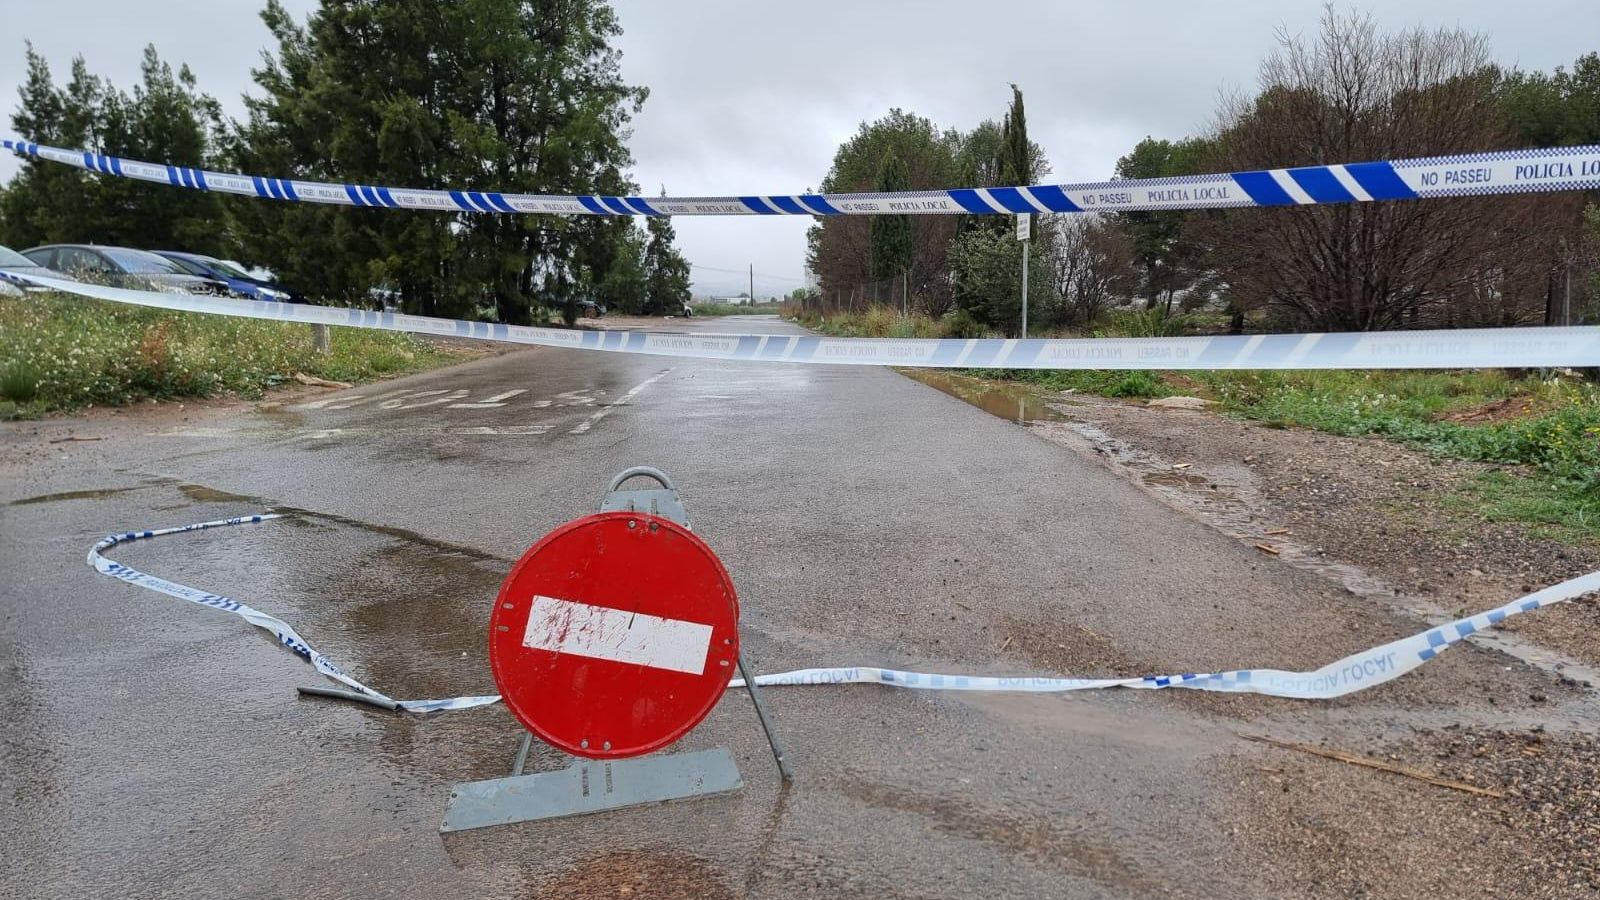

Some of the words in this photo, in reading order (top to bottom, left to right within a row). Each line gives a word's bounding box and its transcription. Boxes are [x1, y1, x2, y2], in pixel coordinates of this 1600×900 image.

[1421, 171, 1439, 186] NO
[1445, 168, 1492, 184] PASSEU
[1515, 162, 1574, 180] POLICIA
[1082, 194, 1096, 205] NO
[1099, 192, 1132, 204] PASSEU
[1147, 189, 1190, 202] POLICIA
[1193, 187, 1230, 200] LOCAL
[854, 203, 880, 212] PASSEU
[889, 201, 920, 211] POLICIA
[922, 200, 949, 211] LOCAL
